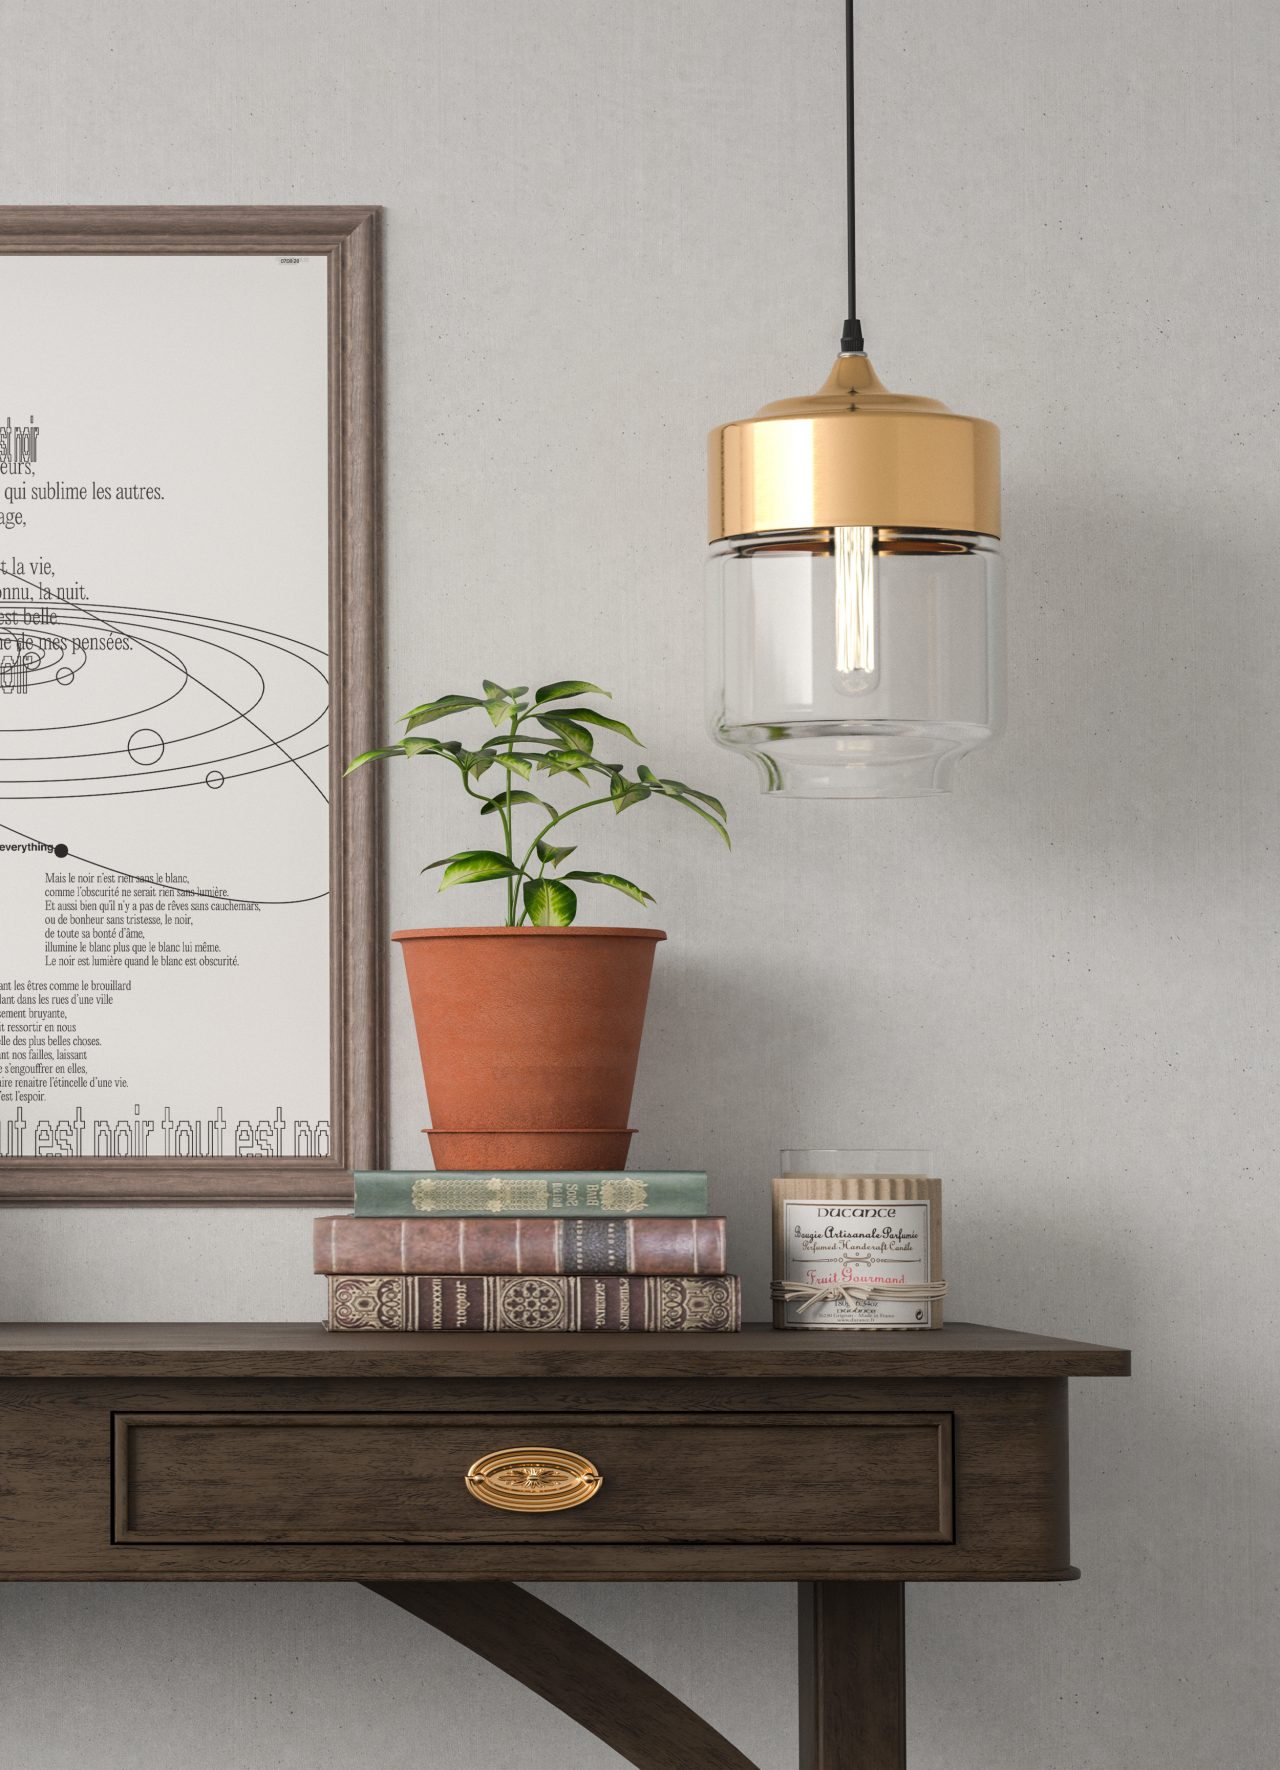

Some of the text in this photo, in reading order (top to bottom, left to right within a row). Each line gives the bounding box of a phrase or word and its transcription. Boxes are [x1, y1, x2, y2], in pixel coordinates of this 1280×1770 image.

[5, 481, 26, 505] qui
[32, 481, 87, 500] sublime
[93, 481, 111, 500] les
[116, 484, 164, 500] autres.
[38, 581, 52, 600] la
[56, 581, 89, 600] nuit.
[45, 913, 193, 927] ou de bonheur sans tristesse, le noir,
[45, 954, 56, 966] Le
[59, 954, 75, 966] noir
[78, 956, 90, 966] est
[92, 954, 122, 966] lumière
[124, 954, 149, 970] quand
[152, 954, 158, 966] le
[161, 954, 183, 966] blanc
[185, 956, 197, 966] est
[14, 979, 25, 991] les
[27, 979, 47, 991] êtres
[49, 982, 79, 991] comme
[82, 979, 88, 991] le
[91, 979, 132, 991] brouillard
[29, 1007, 67, 1022] bruyante,
[8, 1020, 42, 1032] ressortir
[45, 1023, 54, 1032] en
[57, 1023, 76, 1032] nous
[12, 1051, 26, 1060] nos
[29, 1048, 54, 1062] failles,
[57, 1048, 87, 1060] laissant
[34, 1106, 86, 1157] est
[93, 1104, 155, 1157] noir
[161, 1106, 227, 1157] tout
[234, 1106, 286, 1157] est
[824, 1225, 881, 1239] Artisanale
[806, 1266, 906, 1285] Fruit Gourmand
